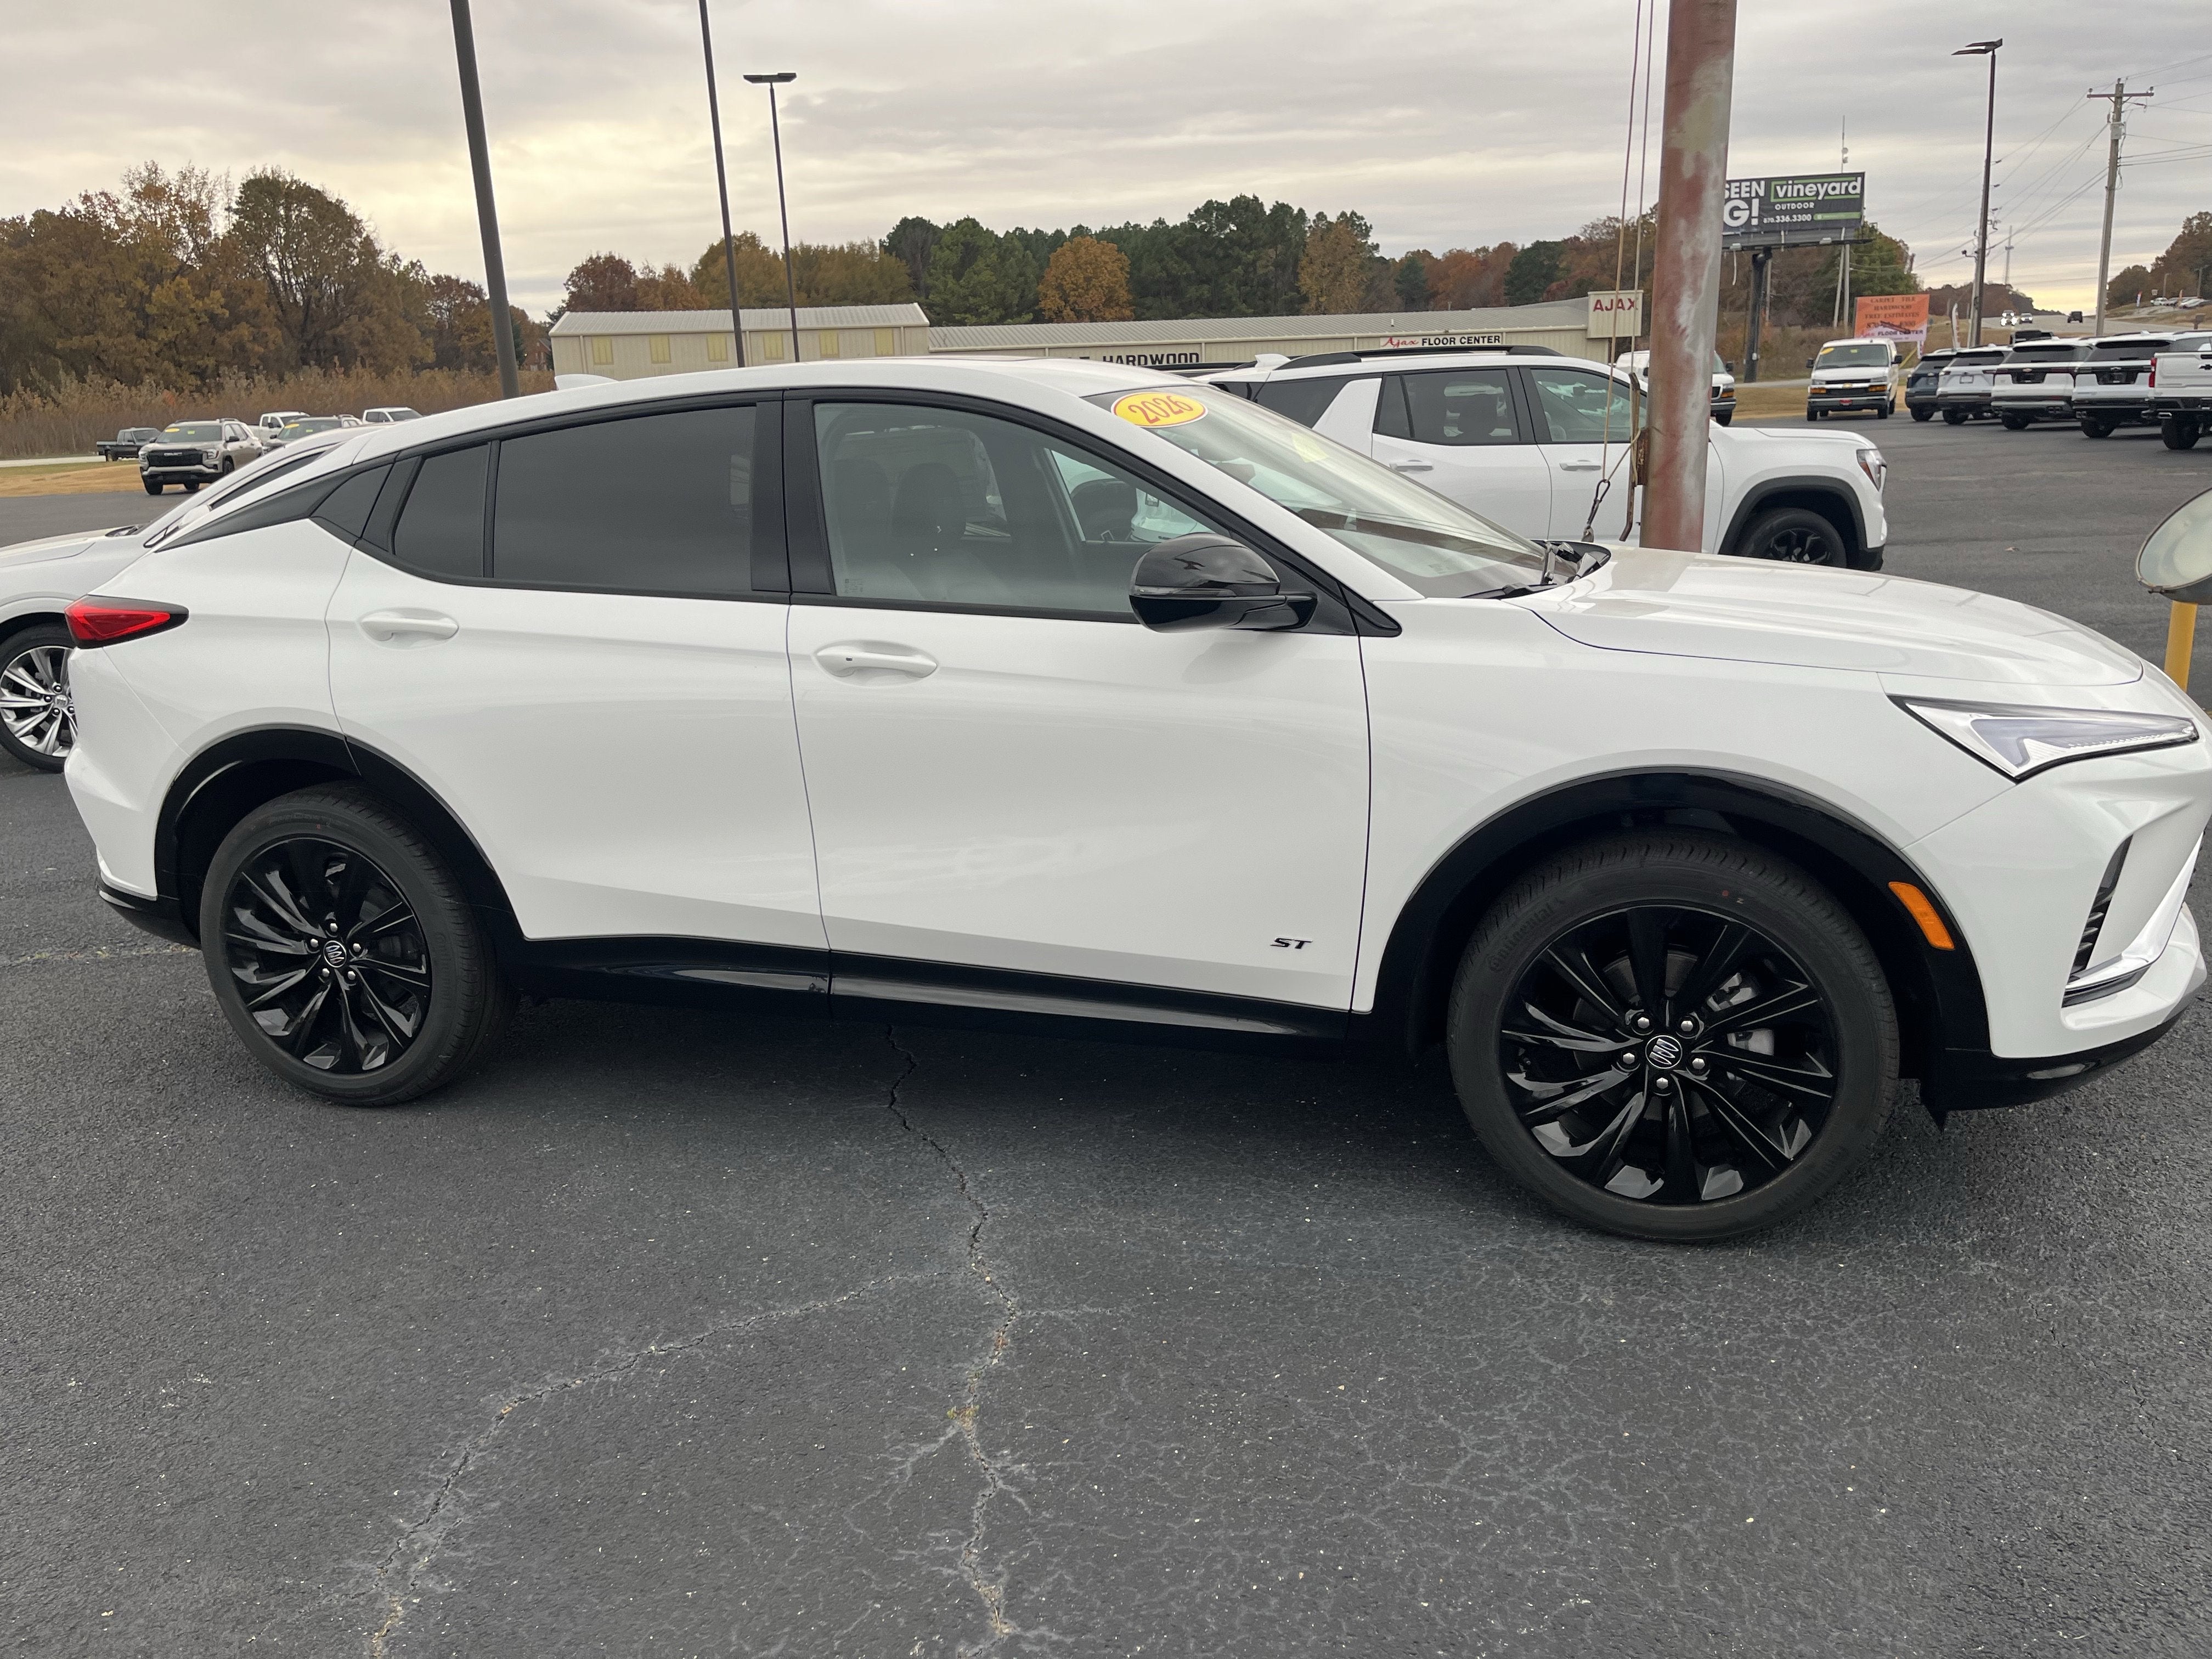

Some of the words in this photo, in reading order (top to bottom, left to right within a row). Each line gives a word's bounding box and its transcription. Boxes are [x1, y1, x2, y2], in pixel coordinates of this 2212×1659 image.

[1775, 177, 1862, 200] vineyard
[1723, 198, 1759, 228] G!
[1774, 202, 1815, 211] OUTDOOR
[1593, 298, 1638, 312] AJAX
[1380, 336, 1419, 348] Ajax
[1421, 337, 1455, 346] FLOOR
[1459, 335, 1500, 345] CENTER
[1103, 352, 1199, 366] HARDWOOD
[1127, 396, 1194, 424] 2026
[1269, 937, 1313, 949] ST
